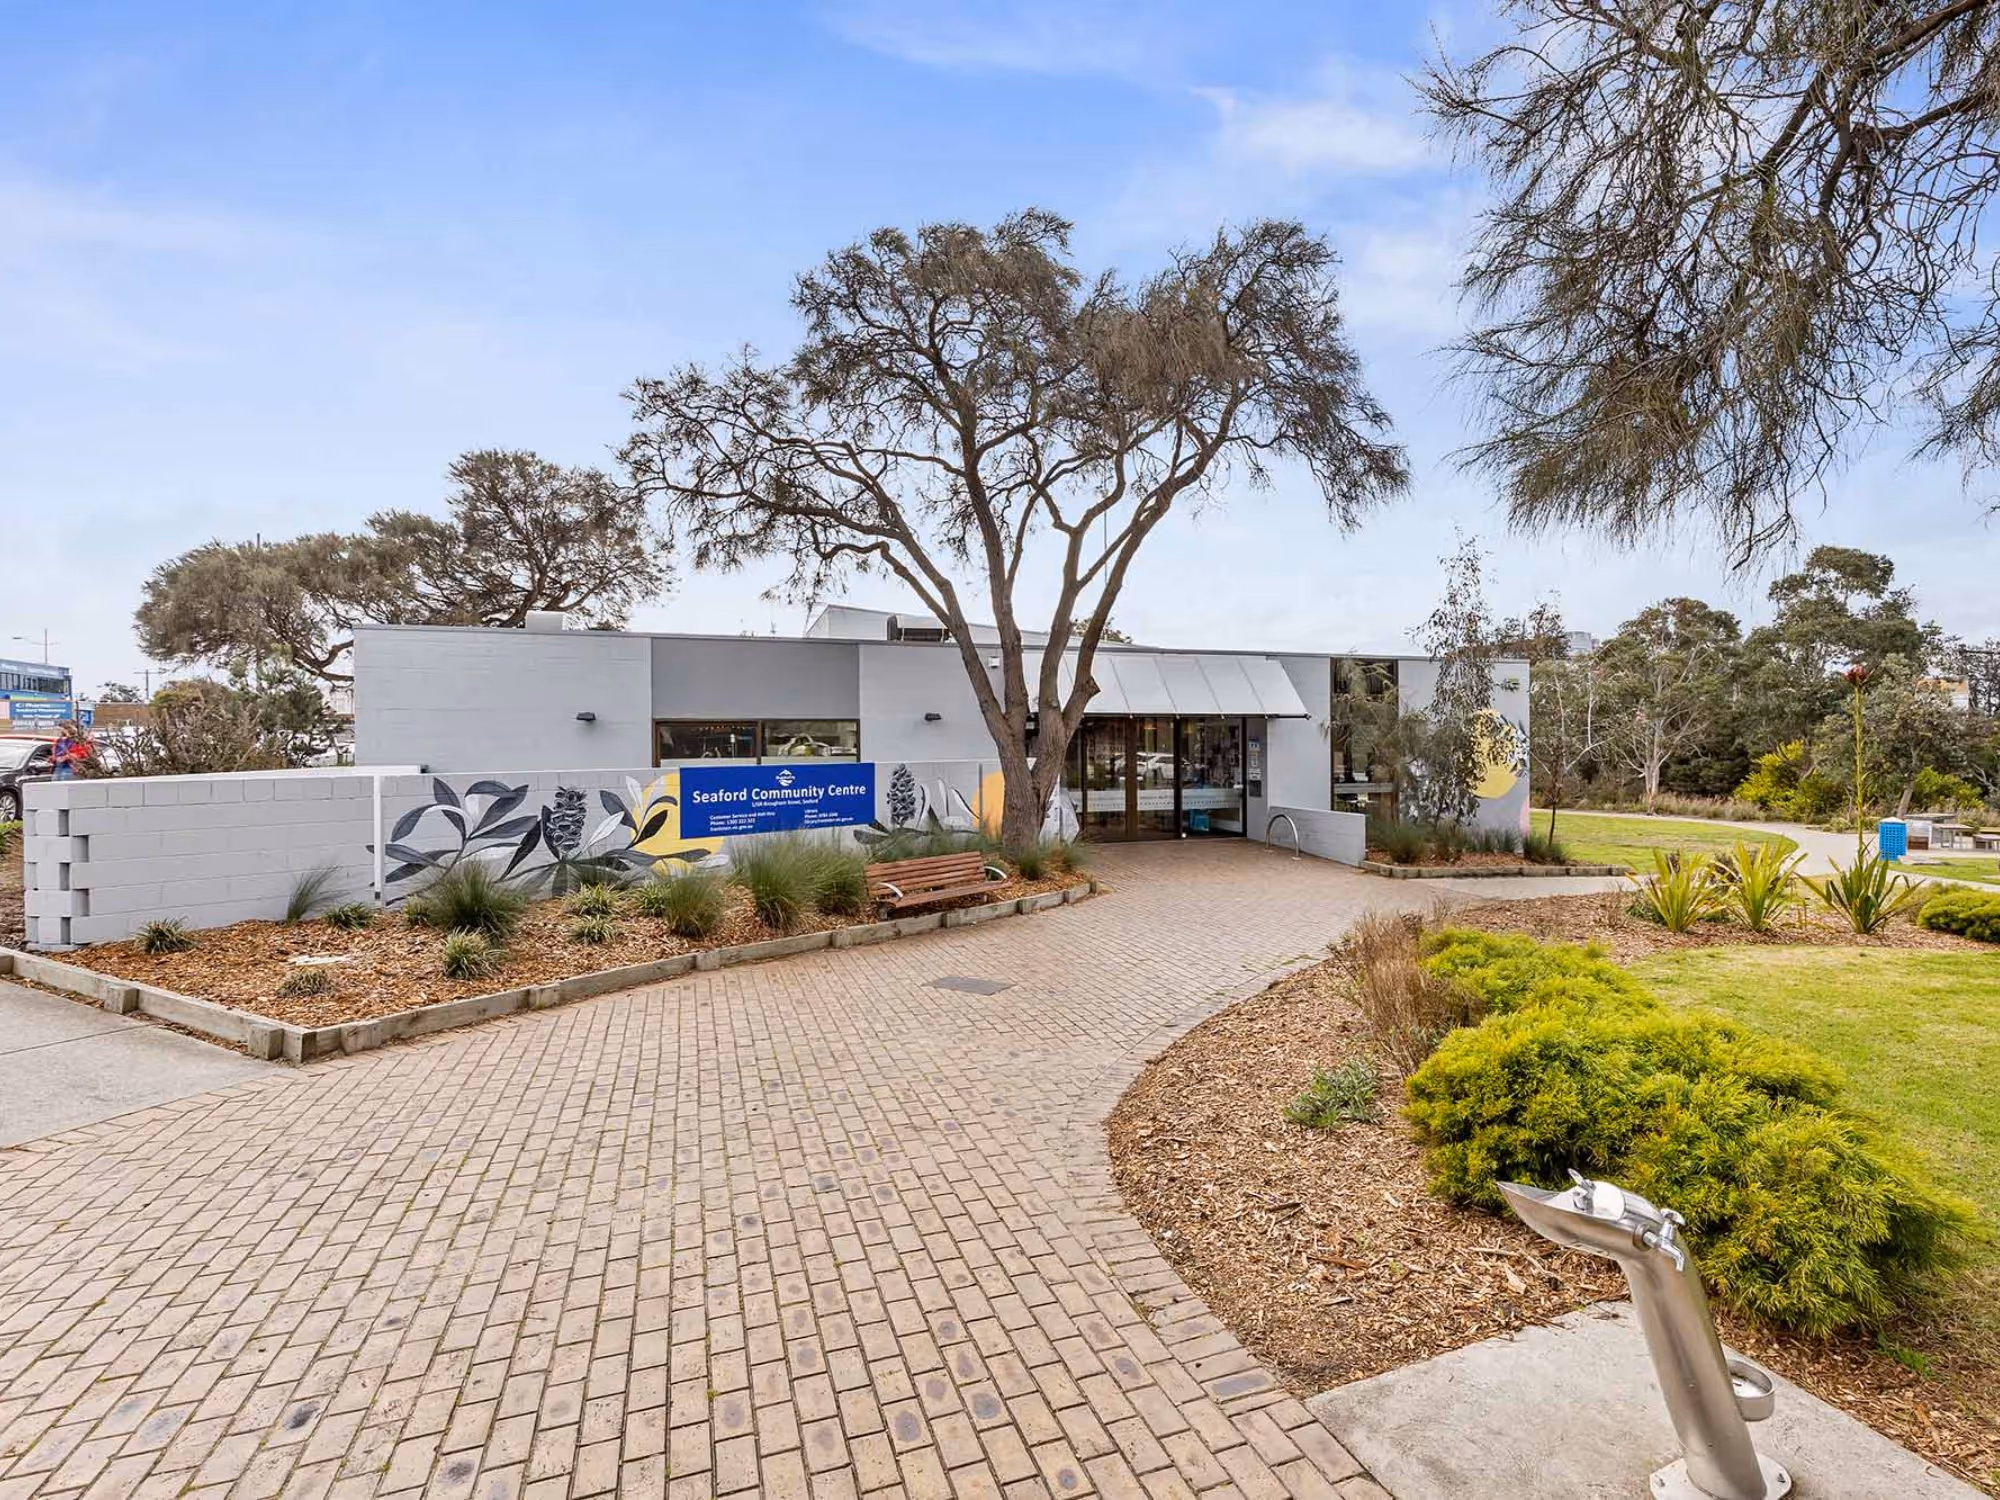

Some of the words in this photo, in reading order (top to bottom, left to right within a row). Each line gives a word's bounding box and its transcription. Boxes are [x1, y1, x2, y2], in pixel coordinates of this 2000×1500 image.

[692, 788, 747, 804] Seaford
[751, 786, 825, 800] Community
[828, 784, 867, 797] Centre
